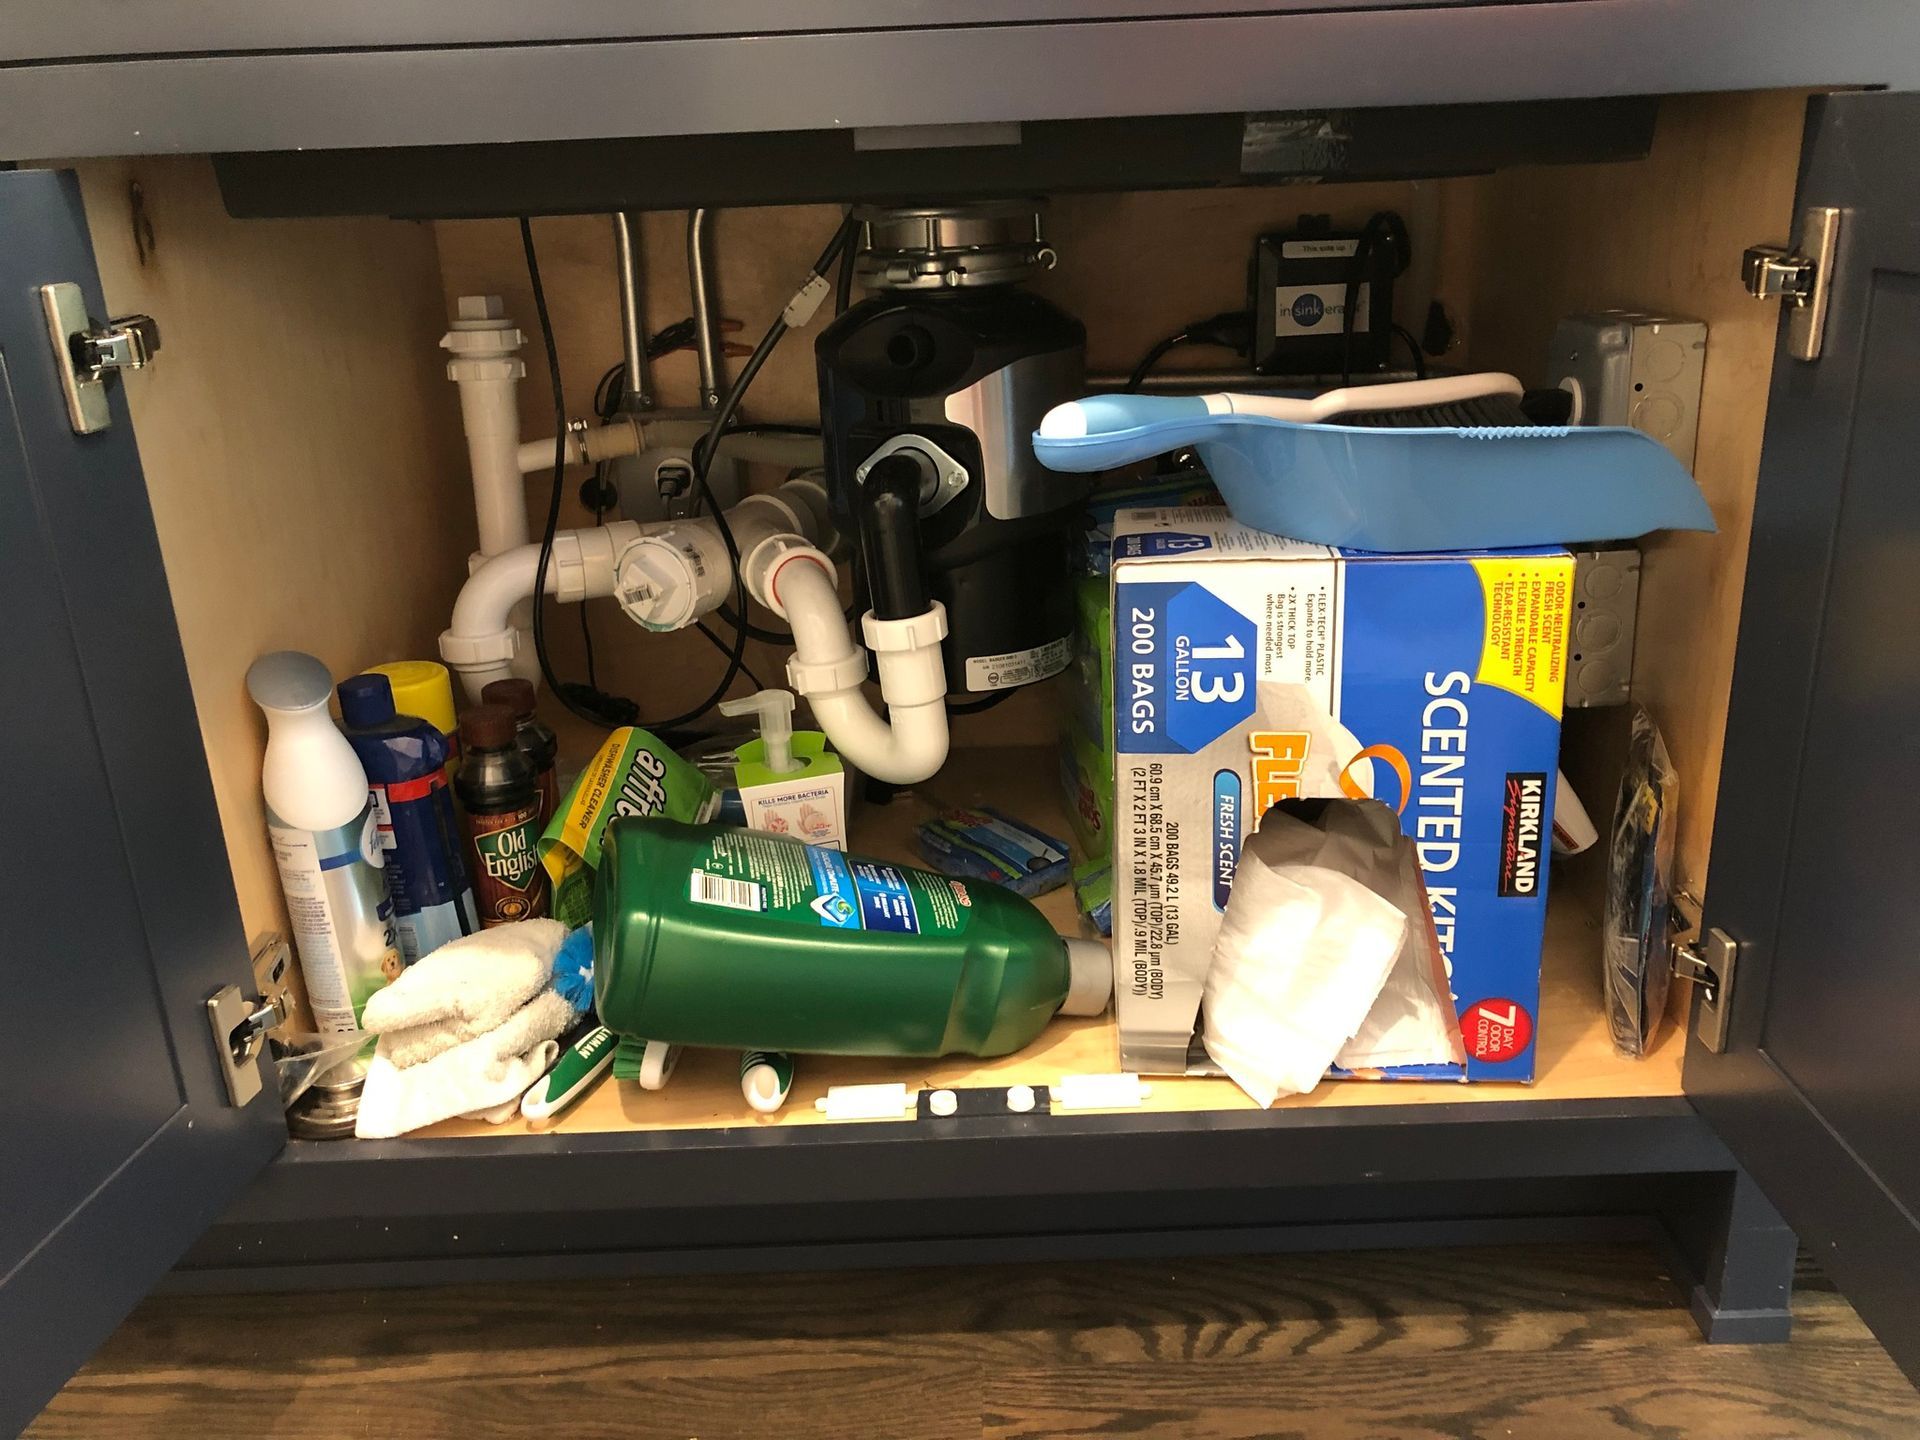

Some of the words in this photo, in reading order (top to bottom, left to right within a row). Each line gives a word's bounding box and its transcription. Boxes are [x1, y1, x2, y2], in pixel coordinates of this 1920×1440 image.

[1266, 593, 1275, 620] where
[1275, 593, 1286, 609] Bag
[1288, 594, 1297, 604] 2X
[1305, 593, 1316, 627] Expands
[1516, 581, 1528, 624] FLEXIBLE
[1544, 581, 1555, 611] FRESH
[1288, 607, 1296, 631] THICK
[1491, 581, 1504, 647] TECHNOLOGY
[1501, 581, 1514, 660] TEAR-RESISTANT
[1528, 581, 1541, 644] EXPANDABLE
[1131, 607, 1155, 655] 200
[1265, 621, 1274, 651] needed
[1274, 620, 1284, 659] strongest
[1287, 634, 1296, 649] TOP
[1306, 629, 1314, 638] to
[1542, 614, 1553, 644] SCENT
[1549, 581, 1566, 682] ODOR-NEUTRALIZING
[1305, 640, 1314, 658] hold
[1316, 643, 1325, 676] PLASTIC
[1513, 626, 1525, 676] STRENGTH
[1175, 635, 1190, 701] GALLON
[1190, 634, 1245, 704] 13
[1525, 647, 1537, 693] CAPACITY
[1131, 663, 1155, 735] BAGS
[596, 743, 621, 788] DISHWASHER
[1131, 767, 1146, 777] (2
[1150, 763, 1163, 784] 60.9
[1416, 671, 1471, 873] SCENTED
[797, 789, 829, 799] BACTERIA
[1134, 780, 1146, 792] FT
[1150, 786, 1160, 801] cm
[1249, 732, 1311, 833] FLE
[579, 788, 602, 829] CLEANER
[1134, 813, 1146, 826] FT
[1150, 813, 1162, 833] 68.5
[1219, 795, 1235, 839] FRESH
[497, 828, 526, 857] Old
[1134, 837, 1147, 848] IN
[1150, 836, 1160, 850] cm
[1166, 822, 1179, 840] 200
[1503, 780, 1522, 893] Signature
[1515, 780, 1542, 893] KIRKLAND
[1134, 860, 1147, 875] 1.8
[1166, 843, 1179, 870] BAGS
[1219, 842, 1234, 889] SCENT
[1134, 877, 1147, 895] MIL
[1150, 862, 1163, 882] 45.7
[1166, 872, 1179, 893] 49.2
[1131, 898, 1147, 937] (TOP)/.9
[1148, 901, 1163, 949] (TOP)/22.8
[1163, 905, 1179, 920] (13
[1134, 939, 1147, 957] MIL
[1163, 923, 1179, 945] GAL)
[1132, 960, 1147, 996] (BODY))
[1148, 968, 1163, 1000] (BODY)
[1475, 1018, 1489, 1057] CONTROL
[1478, 1005, 1517, 1027] 7
[1503, 1028, 1514, 1049] DAY
[1489, 1024, 1502, 1052] ODOR
[577, 1028, 613, 1059] LIBMAN
